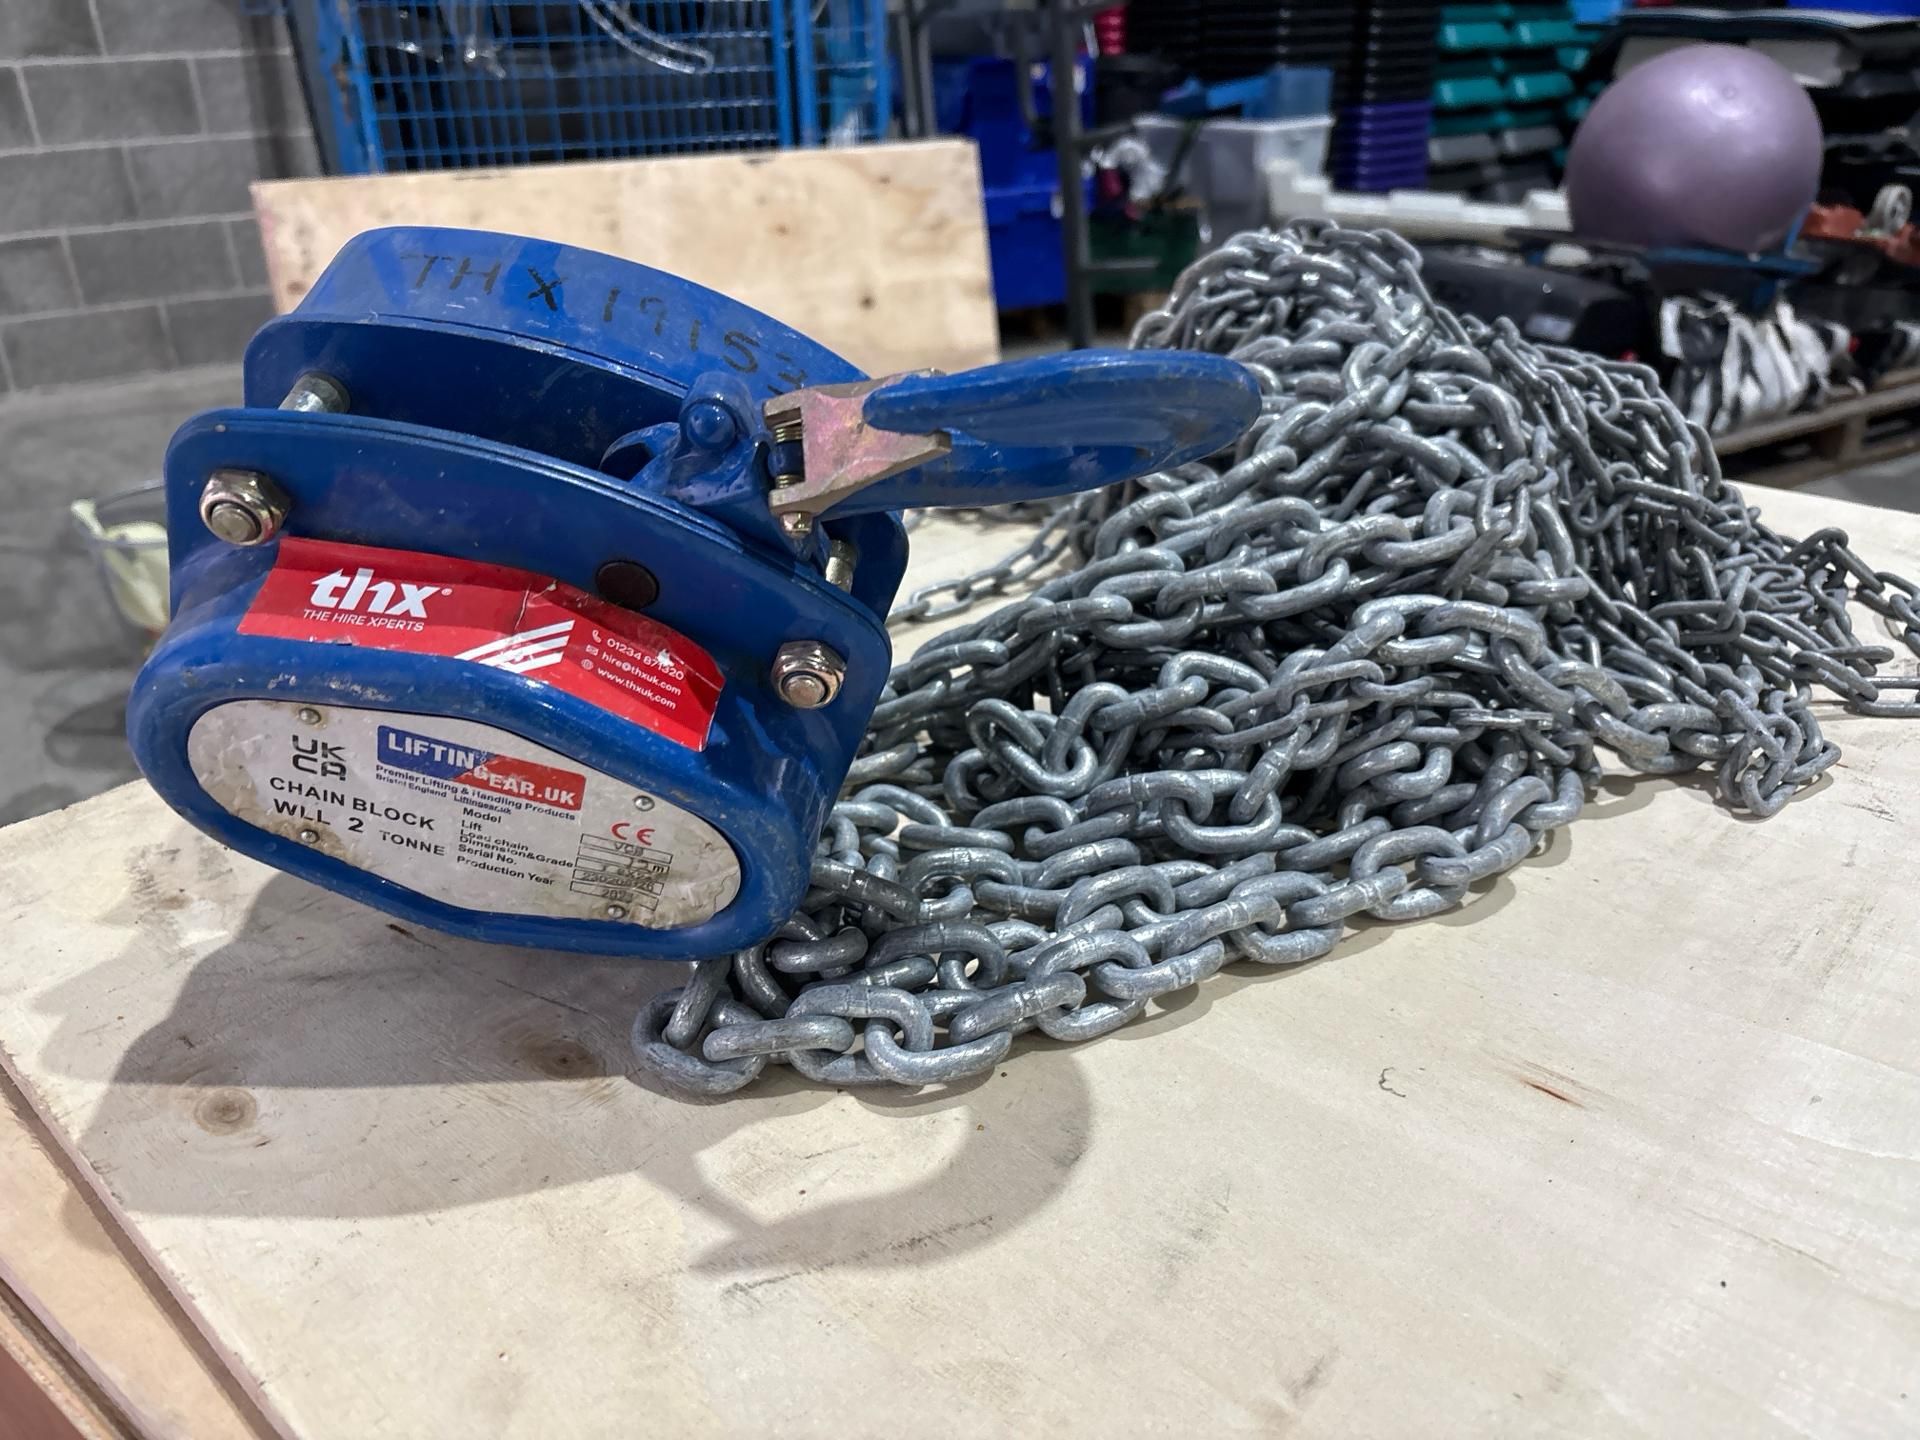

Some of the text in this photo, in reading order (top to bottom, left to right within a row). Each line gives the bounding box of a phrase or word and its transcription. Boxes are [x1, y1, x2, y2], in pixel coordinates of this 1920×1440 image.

[401, 254, 567, 312] THX
[303, 609, 425, 632] THE HIRE XPERTS
[606, 638, 642, 660] 01234
[597, 667, 677, 710] www.thxuk.com
[601, 651, 682, 696] hire@thxuk.com
[375, 773, 407, 787] Bristol
[408, 782, 448, 798] England
[375, 764, 576, 821] Premier Lifting & Handling Products
[269, 777, 435, 831] CHAIN BLOCK
[463, 807, 502, 824] Model
[273, 798, 446, 856] WLL 2 TONNE
[460, 829, 529, 852] Load chain
[611, 822, 655, 846] CE
[458, 843, 494, 860] Serial
[459, 836, 573, 868] Dimension&Grade
[461, 820, 482, 832] Lift
[652, 865, 665, 873] m
[457, 855, 525, 879] Production
[527, 872, 556, 886] Year
